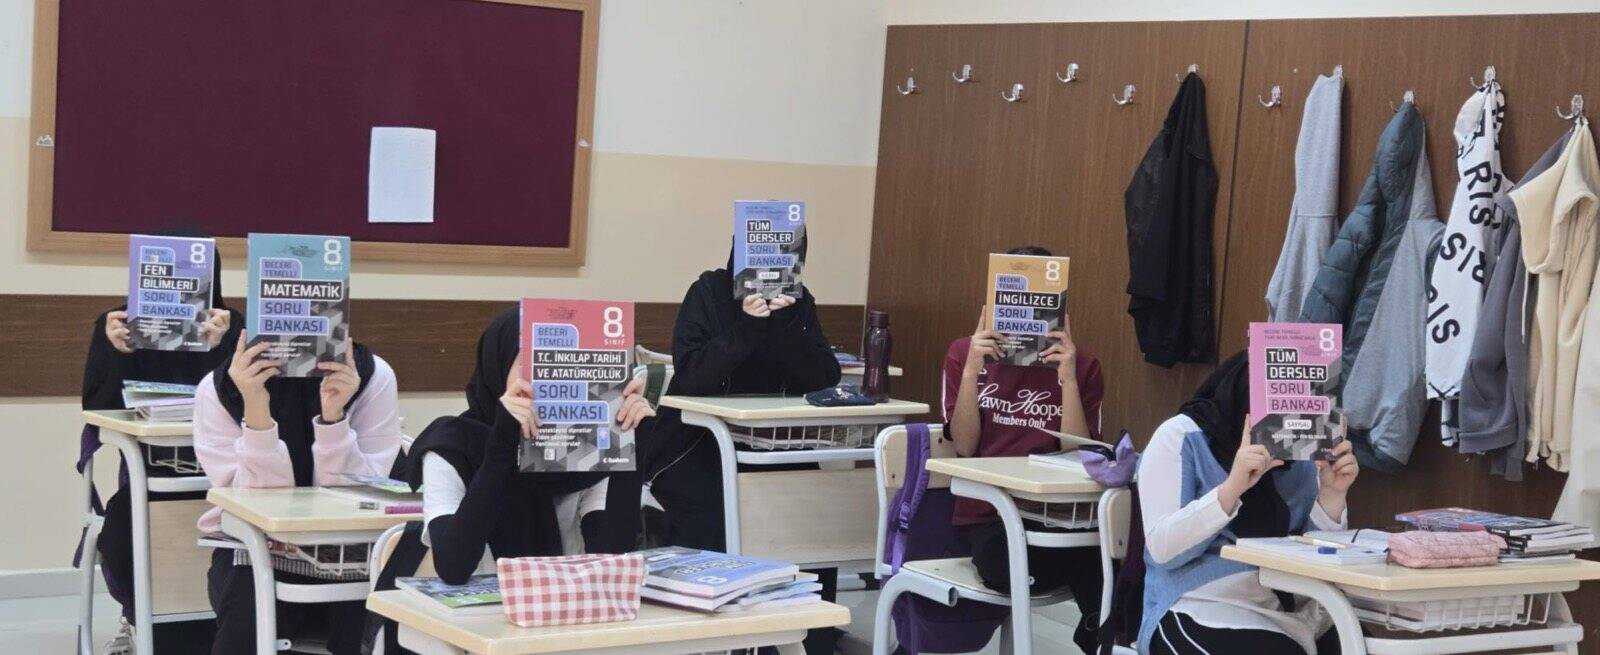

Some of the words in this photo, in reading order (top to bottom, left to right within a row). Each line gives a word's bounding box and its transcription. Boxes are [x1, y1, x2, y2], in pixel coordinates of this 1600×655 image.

[749, 221, 770, 231] TÜM
[749, 233, 791, 243] DERSLER
[749, 245, 775, 254] SORU
[749, 257, 791, 266] BANKASI
[144, 265, 166, 275] FEN
[144, 291, 174, 302] SORU
[263, 283, 340, 298] MATEMATİK
[999, 292, 1054, 306] İNGİLİZCE
[142, 305, 191, 317] BANKASI
[265, 302, 302, 314] SORU
[998, 308, 1027, 319] SORU
[265, 320, 322, 332] BANKASI
[997, 321, 1043, 333] BANKASI
[537, 352, 552, 362] T.C.
[555, 351, 591, 363] İNKILAP
[592, 351, 621, 363] TARİHİ
[1269, 349, 1296, 363] TÜM
[537, 368, 549, 378] VE
[552, 367, 621, 380] ATATÜRKÇÜLÜK
[1270, 366, 1325, 380] DERSLER
[539, 385, 579, 399] SORU
[1271, 383, 1305, 395] SORU
[1272, 399, 1325, 411] BANKASI
[538, 405, 602, 420] BANKASI
[992, 412, 1027, 427] Members
[1028, 418, 1047, 429] Only
